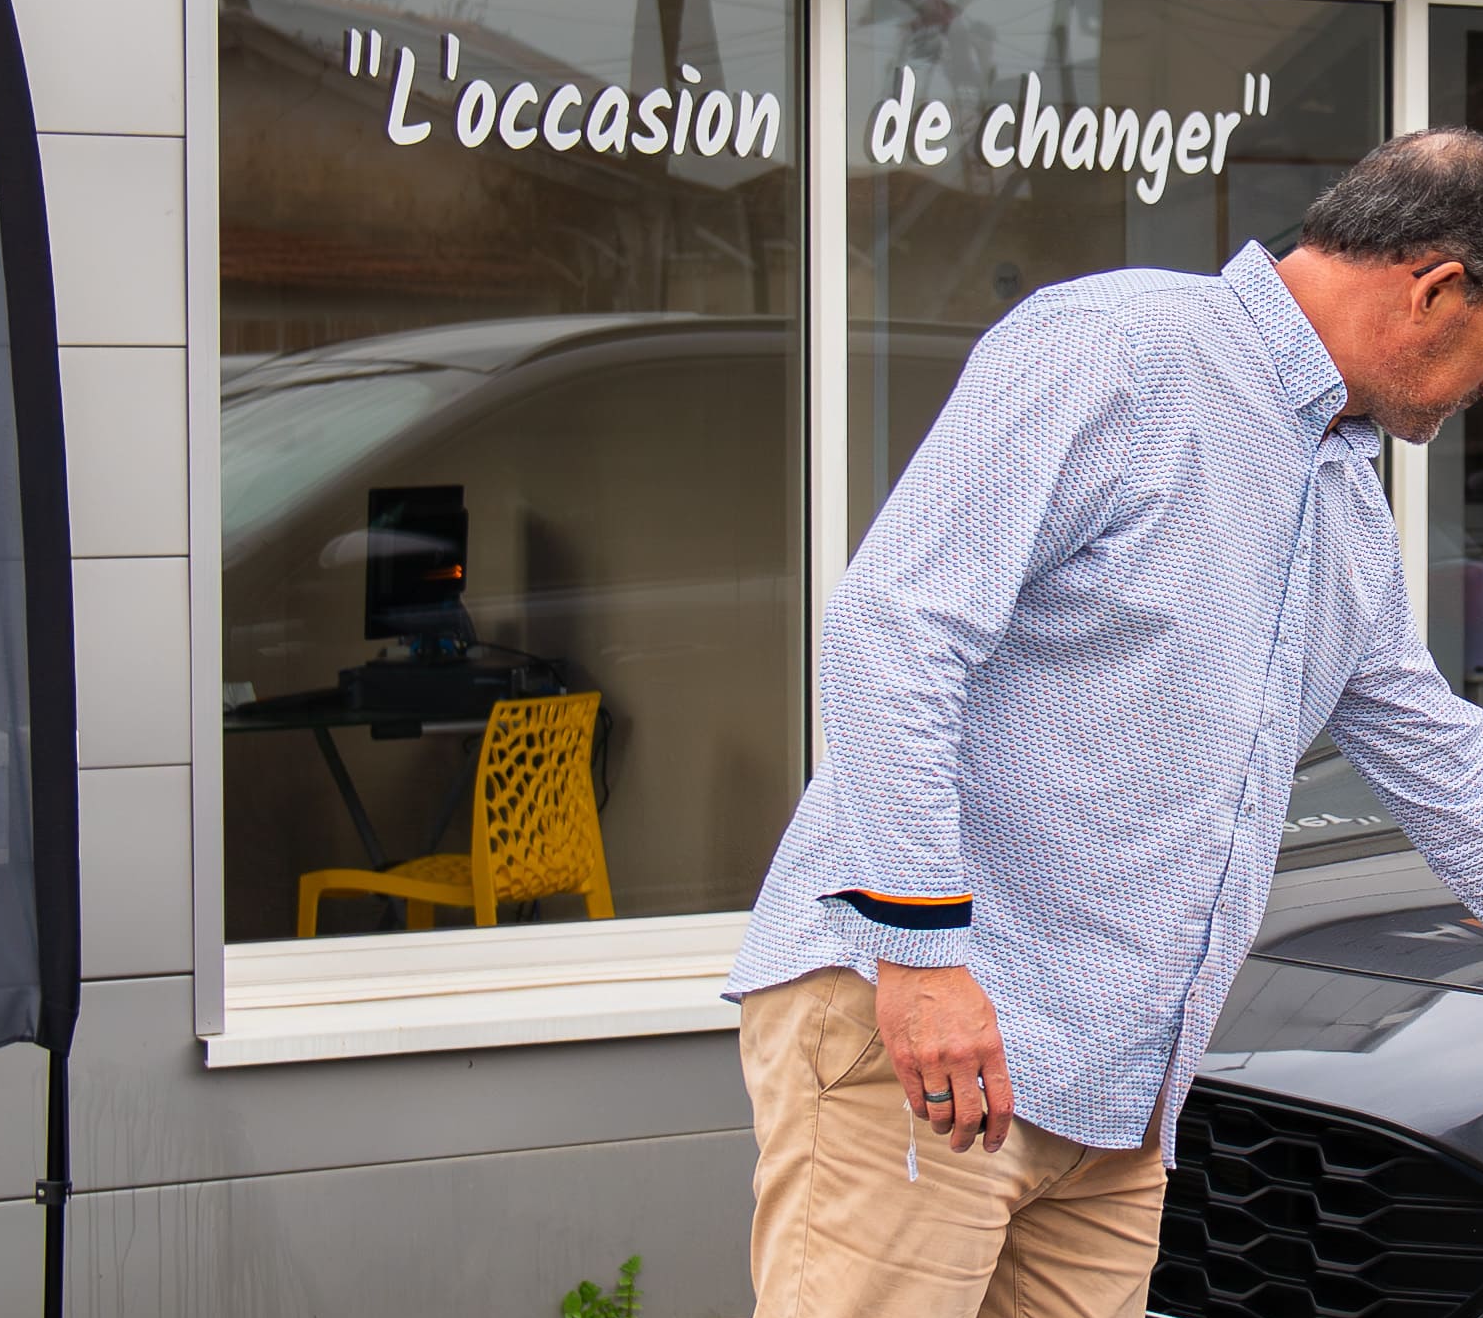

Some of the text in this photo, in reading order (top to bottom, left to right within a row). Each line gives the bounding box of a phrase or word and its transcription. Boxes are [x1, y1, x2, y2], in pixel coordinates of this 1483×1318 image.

[347, 28, 1270, 206] "L'occasion de changer"
